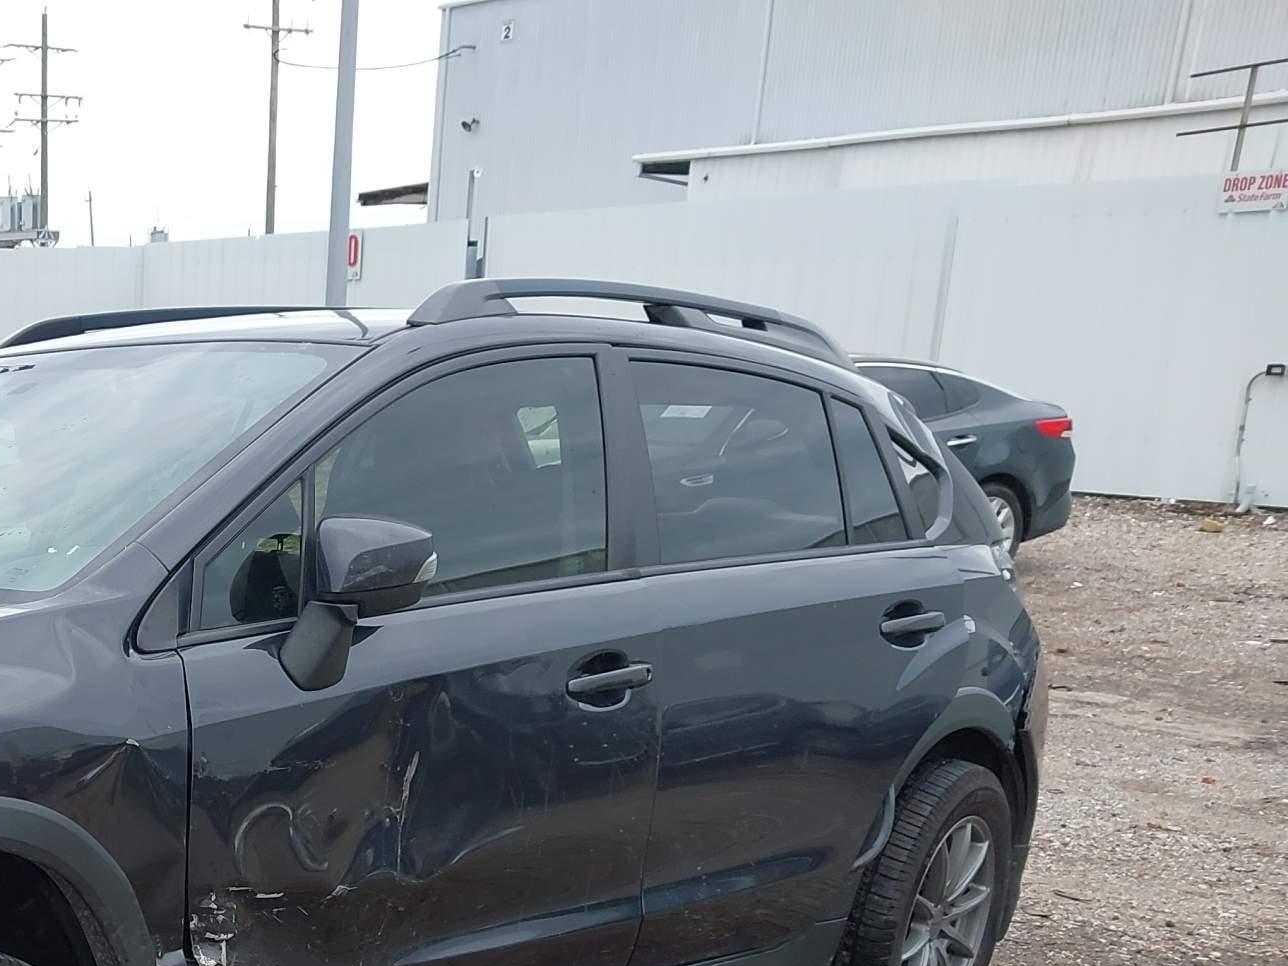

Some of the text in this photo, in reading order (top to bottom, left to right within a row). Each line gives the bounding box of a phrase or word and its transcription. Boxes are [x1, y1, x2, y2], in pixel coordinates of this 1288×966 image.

[503, 26, 511, 39] 2
[1223, 173, 1288, 193] DROP ZONE
[1237, 192, 1282, 203] State Farm
